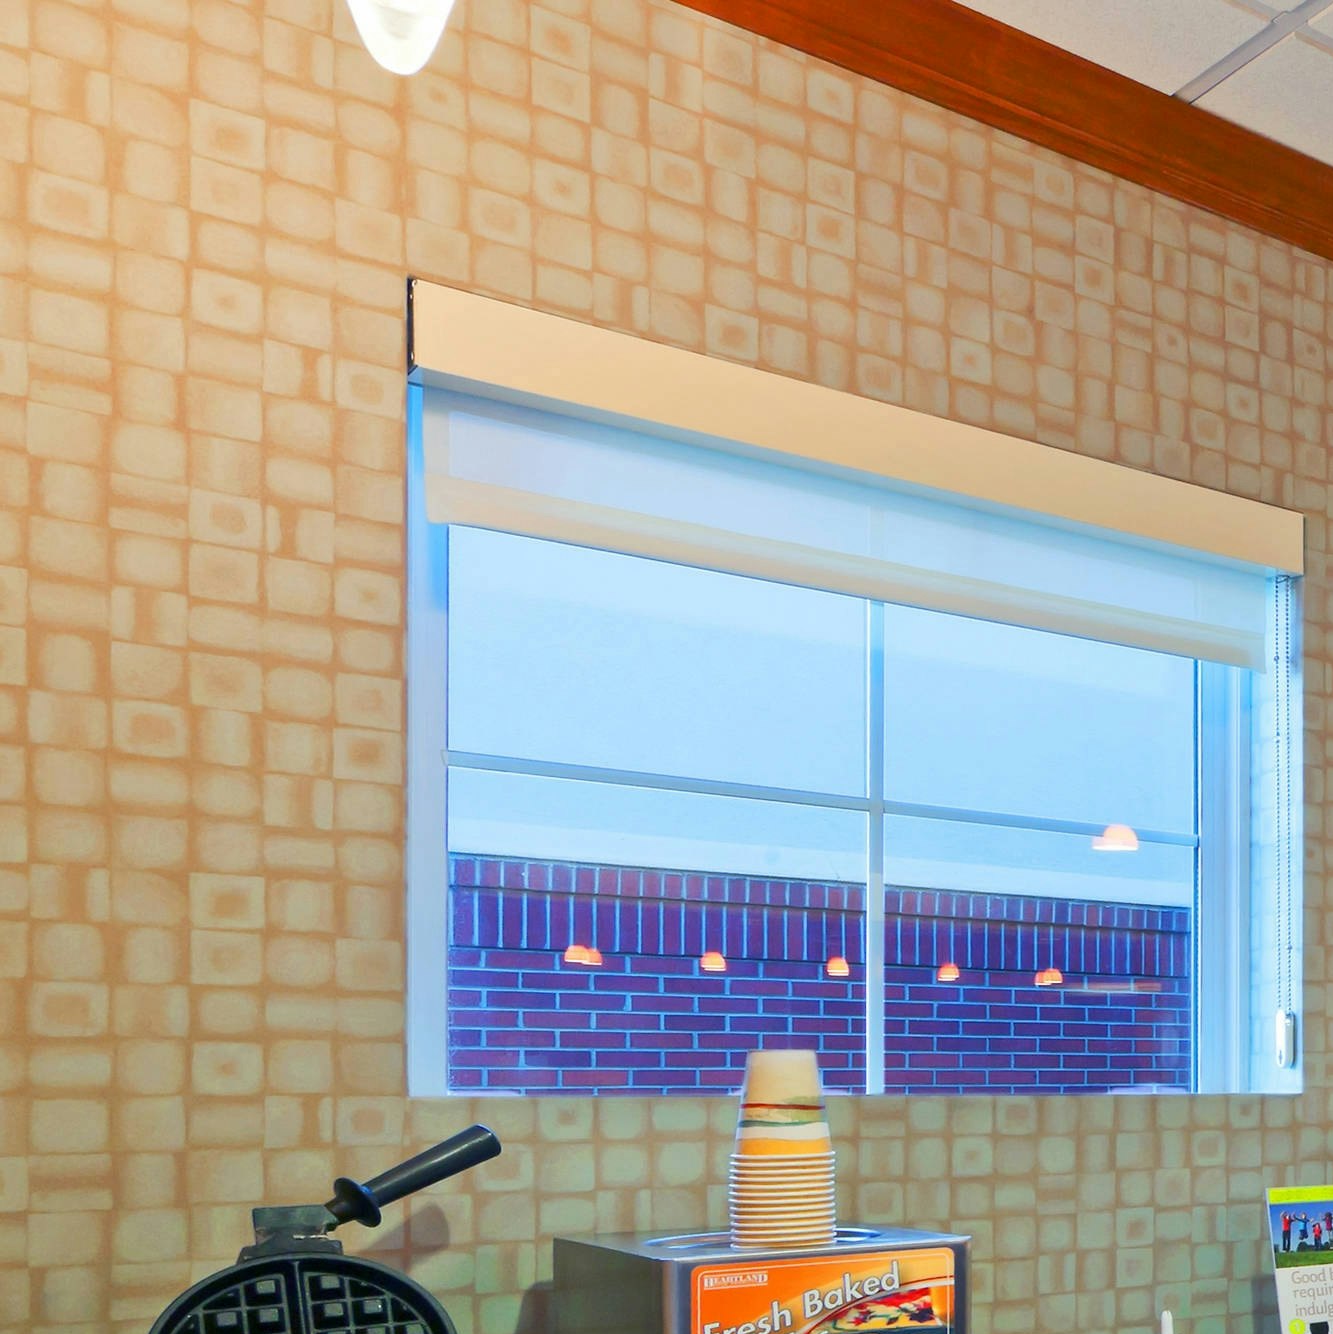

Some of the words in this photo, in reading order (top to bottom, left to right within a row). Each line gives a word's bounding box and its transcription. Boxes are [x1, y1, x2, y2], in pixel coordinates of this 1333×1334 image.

[704, 1273, 768, 1288] HEARTLAND
[1291, 1268, 1326, 1284] Good
[803, 1260, 900, 1319] Baked
